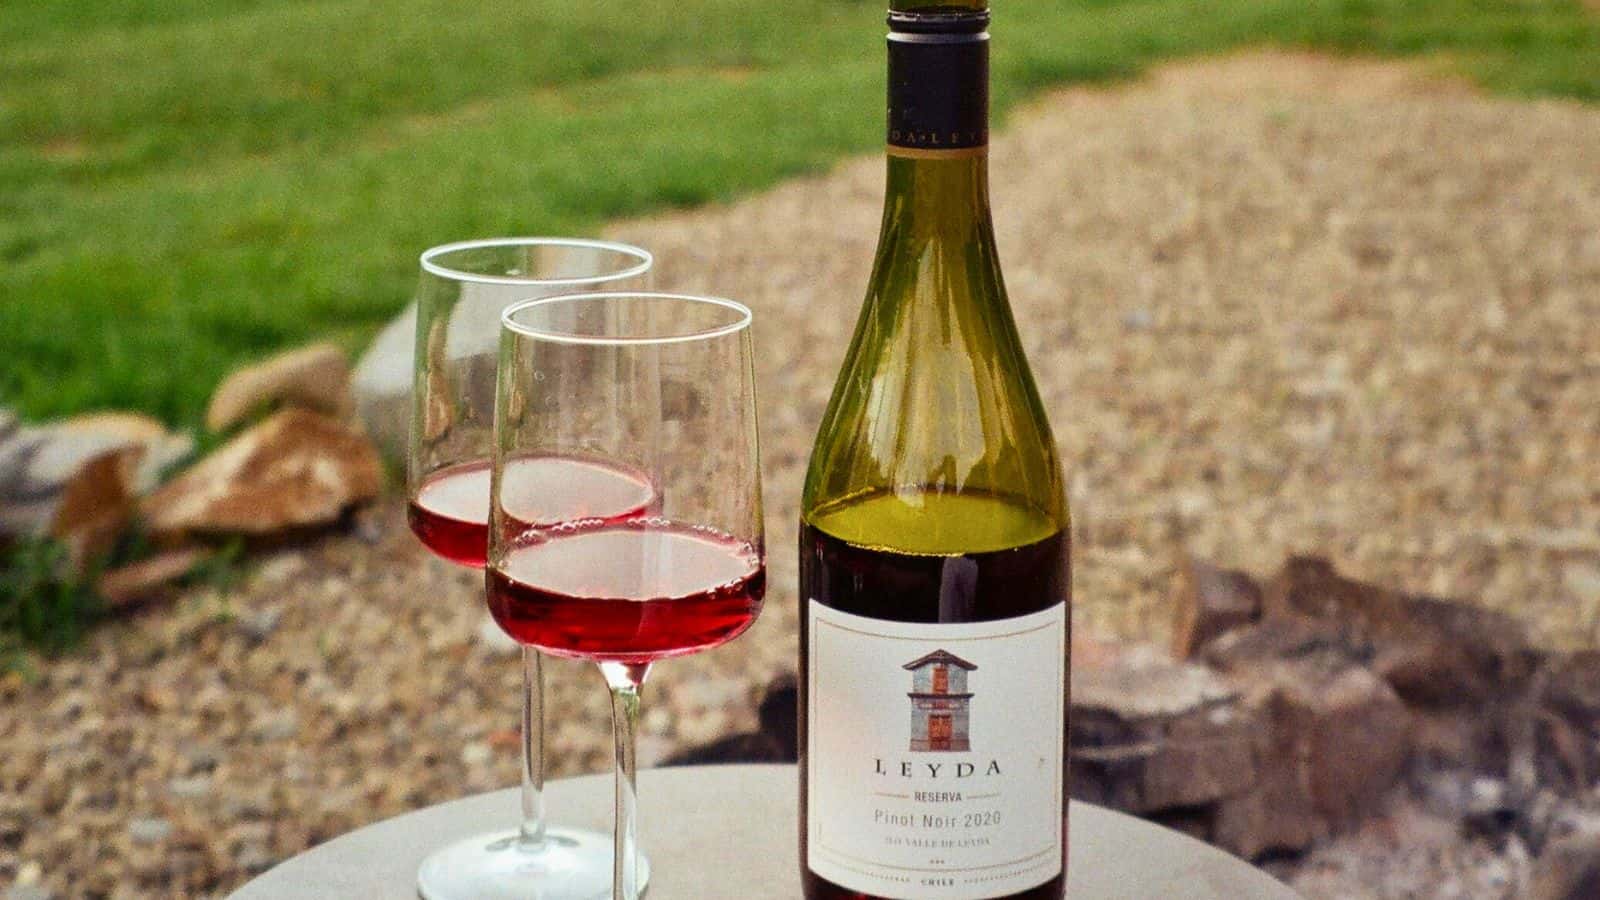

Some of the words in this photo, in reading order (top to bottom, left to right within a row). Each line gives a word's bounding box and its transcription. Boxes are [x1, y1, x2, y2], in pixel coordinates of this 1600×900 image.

[873, 758, 1001, 779] LEYDA
[914, 791, 962, 802] RESERVA
[874, 808, 915, 827] Pinot
[922, 814, 957, 828] Noir
[964, 810, 1001, 828] 2020
[920, 877, 955, 887] CHILE
